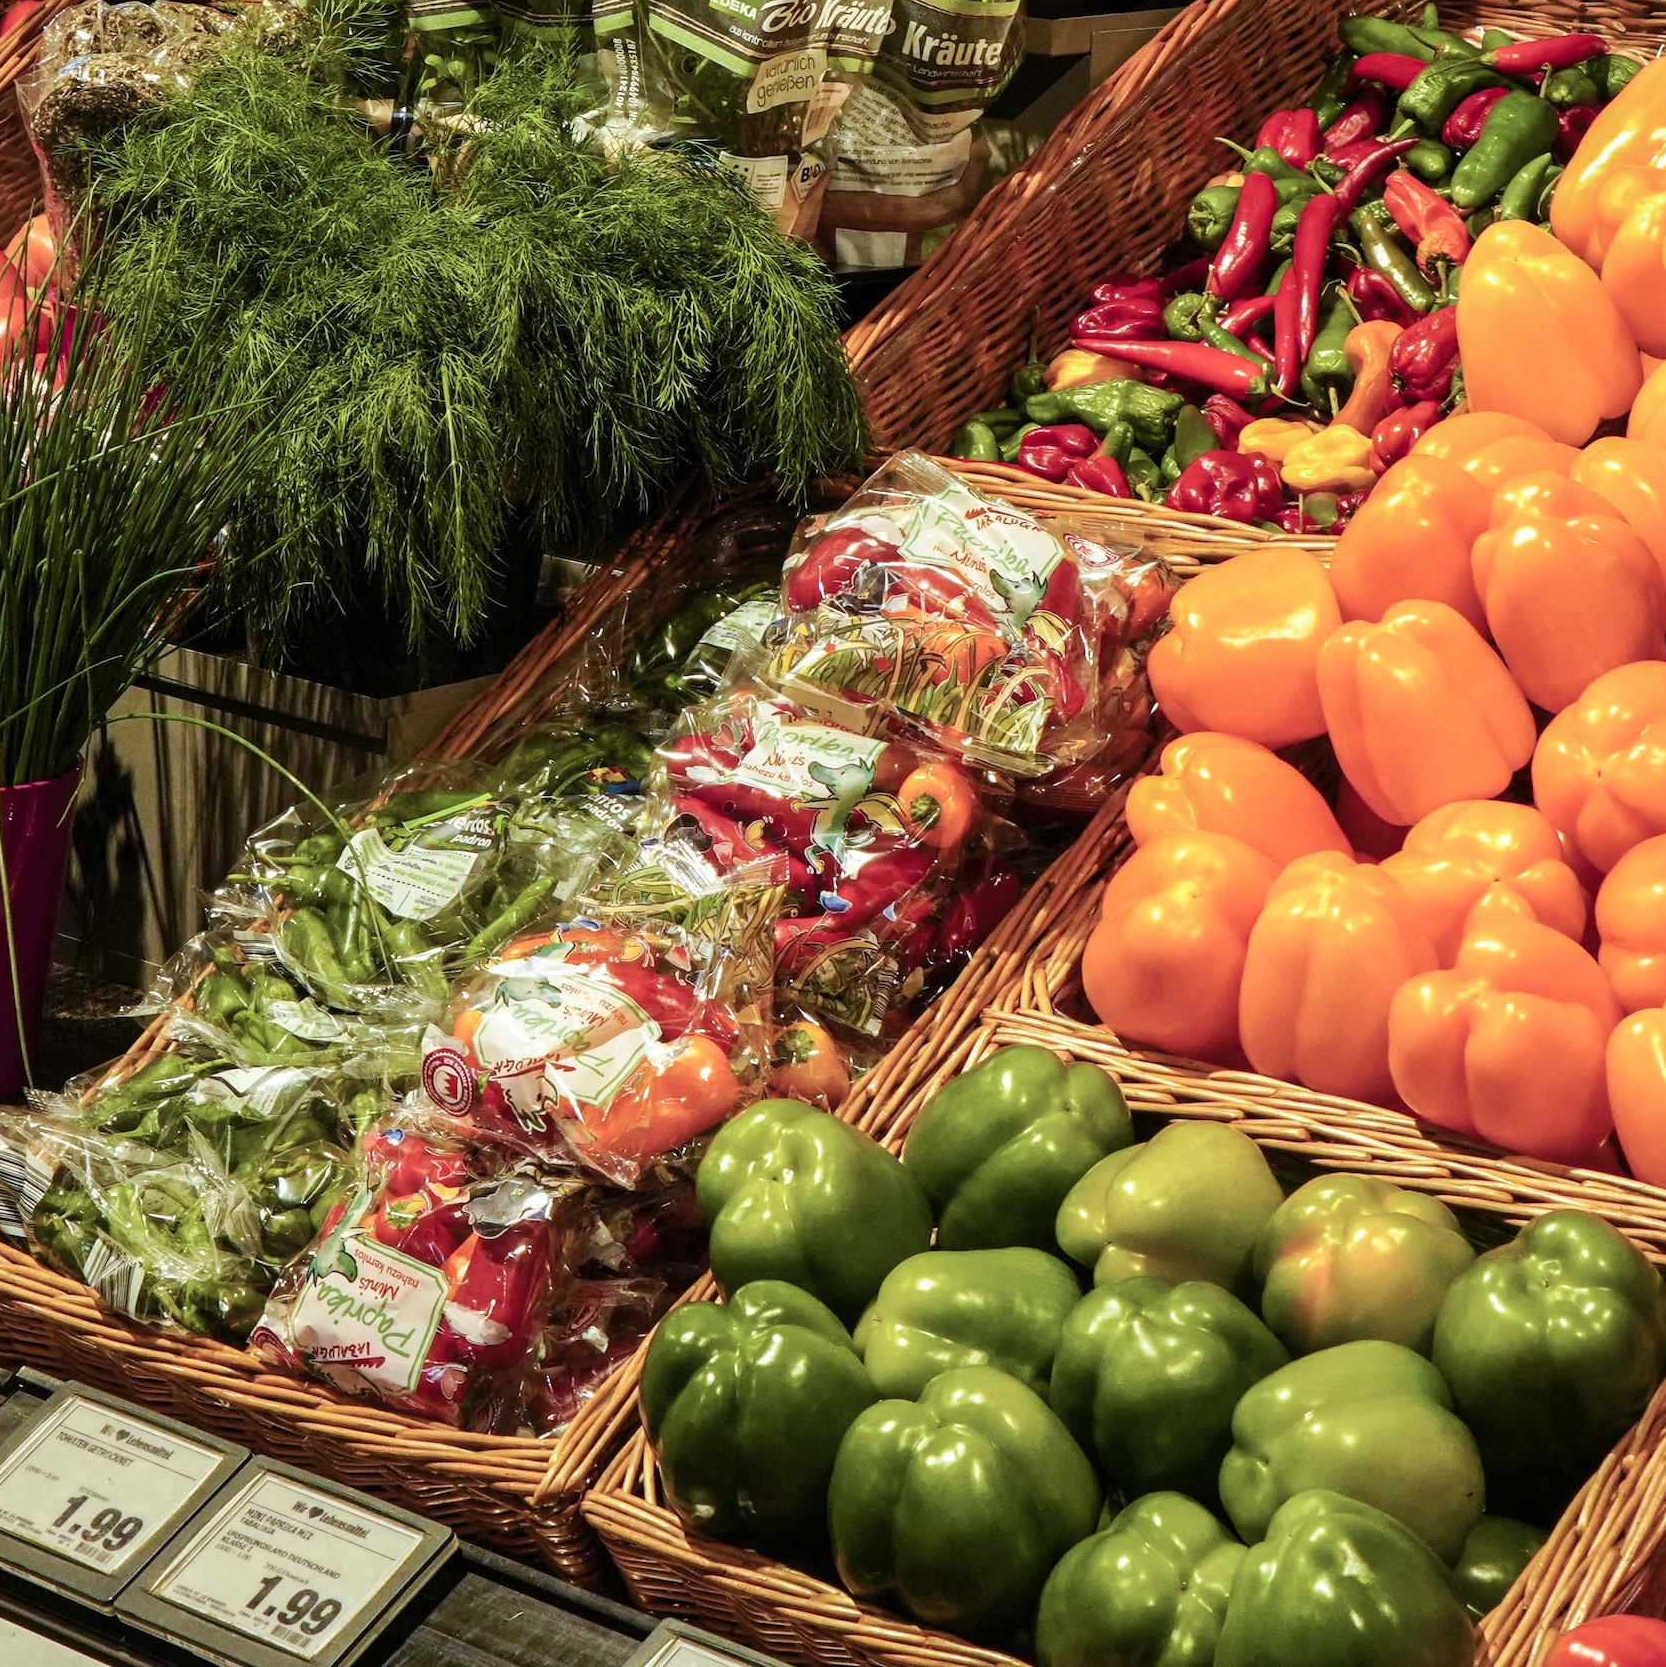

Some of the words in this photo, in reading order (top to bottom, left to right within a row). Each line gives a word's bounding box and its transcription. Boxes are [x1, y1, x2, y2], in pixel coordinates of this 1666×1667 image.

[755, 74, 815, 108] genießen
[950, 550, 987, 573] Minis
[740, 762, 776, 779] nahezu
[580, 802, 624, 834] padron
[451, 832, 492, 849] padron
[354, 1249, 384, 1270] kernlos
[358, 1277, 400, 1300] Minis
[385, 1266, 419, 1289] nahezu
[317, 1282, 415, 1358] Paprika
[56, 1431, 89, 1450] TOMATEN
[87, 1444, 135, 1468] GETROCKNET
[125, 1434, 175, 1461] Lebensmittel
[51, 1495, 144, 1552] 1.99
[240, 1517, 275, 1536] TABALUGA
[246, 1509, 266, 1522] MINI
[266, 1514, 300, 1534] PAPRIKA
[298, 1528, 316, 1541] MIX
[292, 1500, 308, 1513] Wir
[319, 1512, 372, 1539] Lebensmittel
[220, 1536, 248, 1552] KLASSE
[227, 1529, 289, 1559] URSPRUNGSLAND
[287, 1551, 341, 1580] DEUTSCHLAND
[245, 1575, 342, 1636] 1.99
